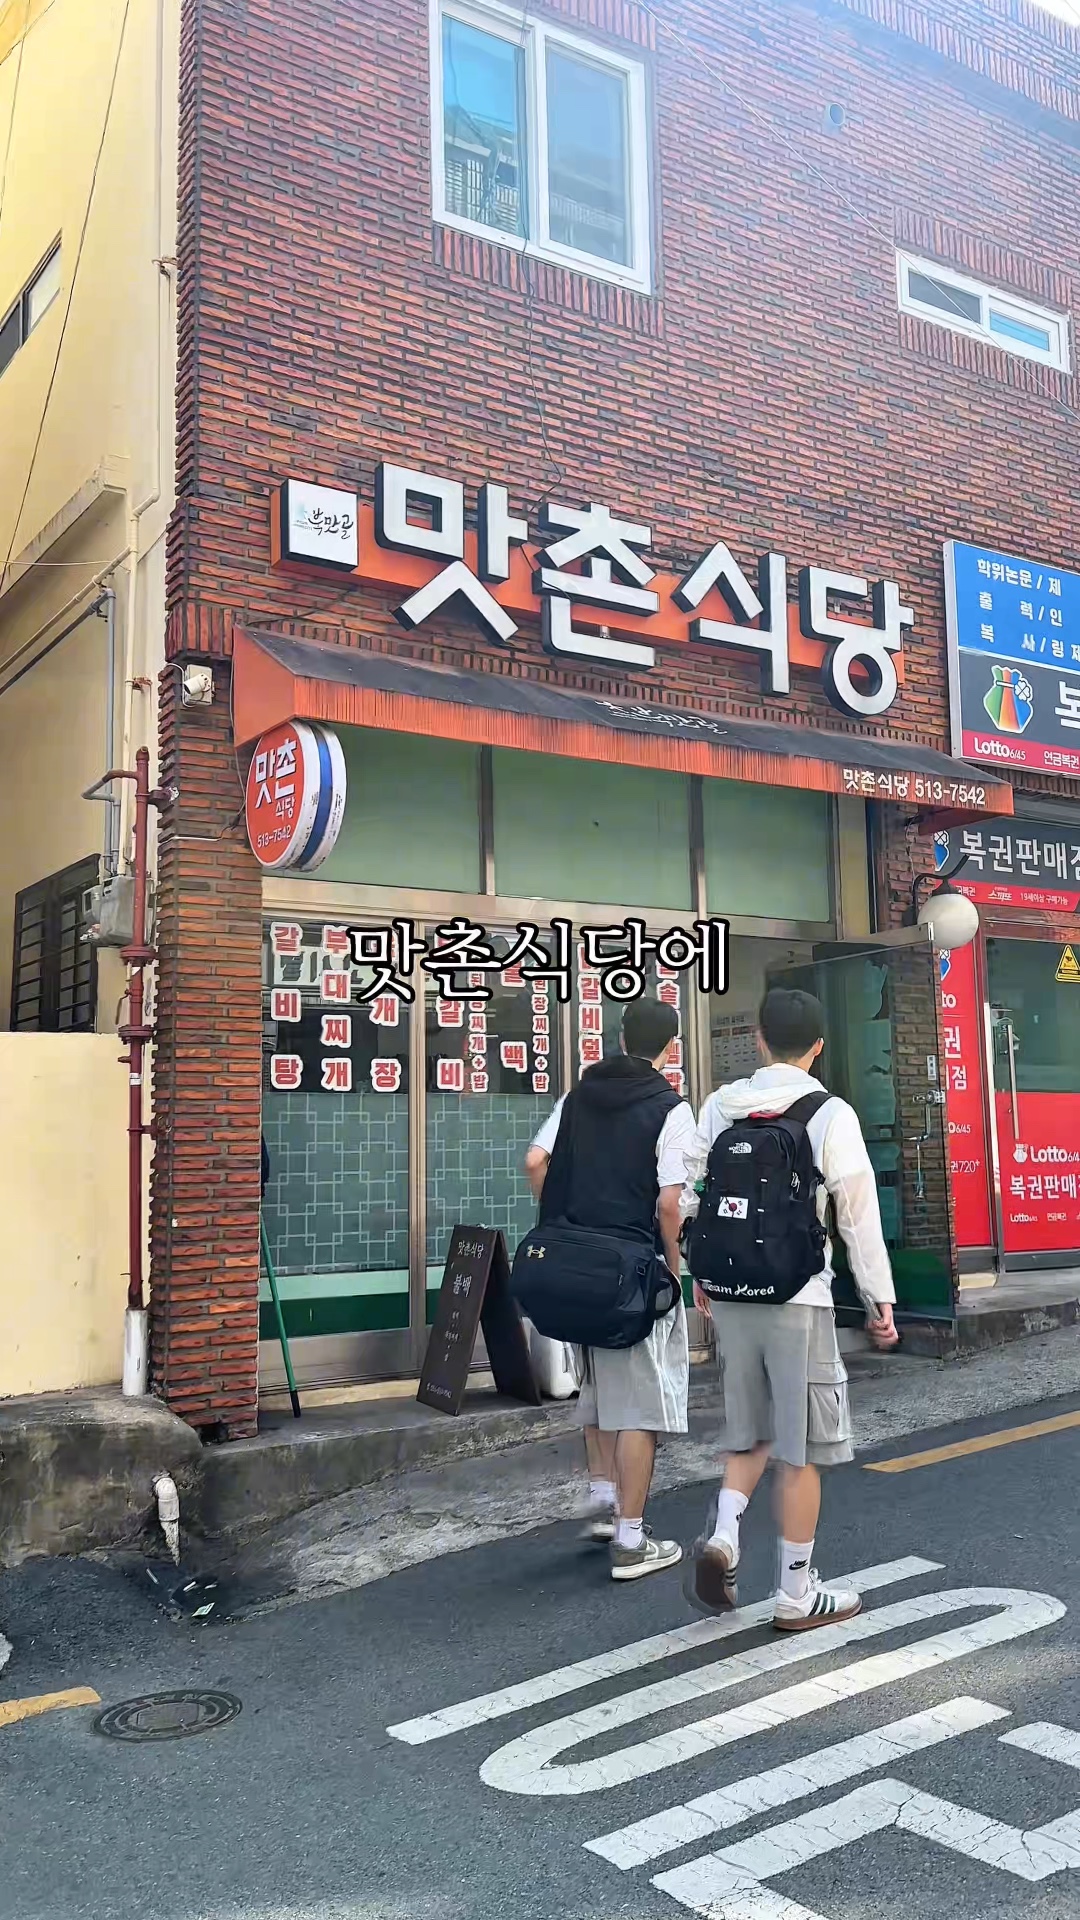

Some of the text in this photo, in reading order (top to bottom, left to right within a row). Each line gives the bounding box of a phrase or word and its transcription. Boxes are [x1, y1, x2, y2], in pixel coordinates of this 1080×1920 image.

[379, 463, 914, 714] 맛촌식당
[977, 558, 1033, 589] 학위논문
[255, 739, 297, 809] 맛촌
[843, 768, 986, 806] 맛촌식당 513-7542
[275, 797, 296, 821] 식당
[257, 825, 292, 848] 513-7542
[274, 926, 301, 1086] 갈비탕
[324, 929, 351, 1087] 부대찌개
[1010, 1174, 1080, 1201] 복권판매
[734, 1284, 775, 1296] Korea
